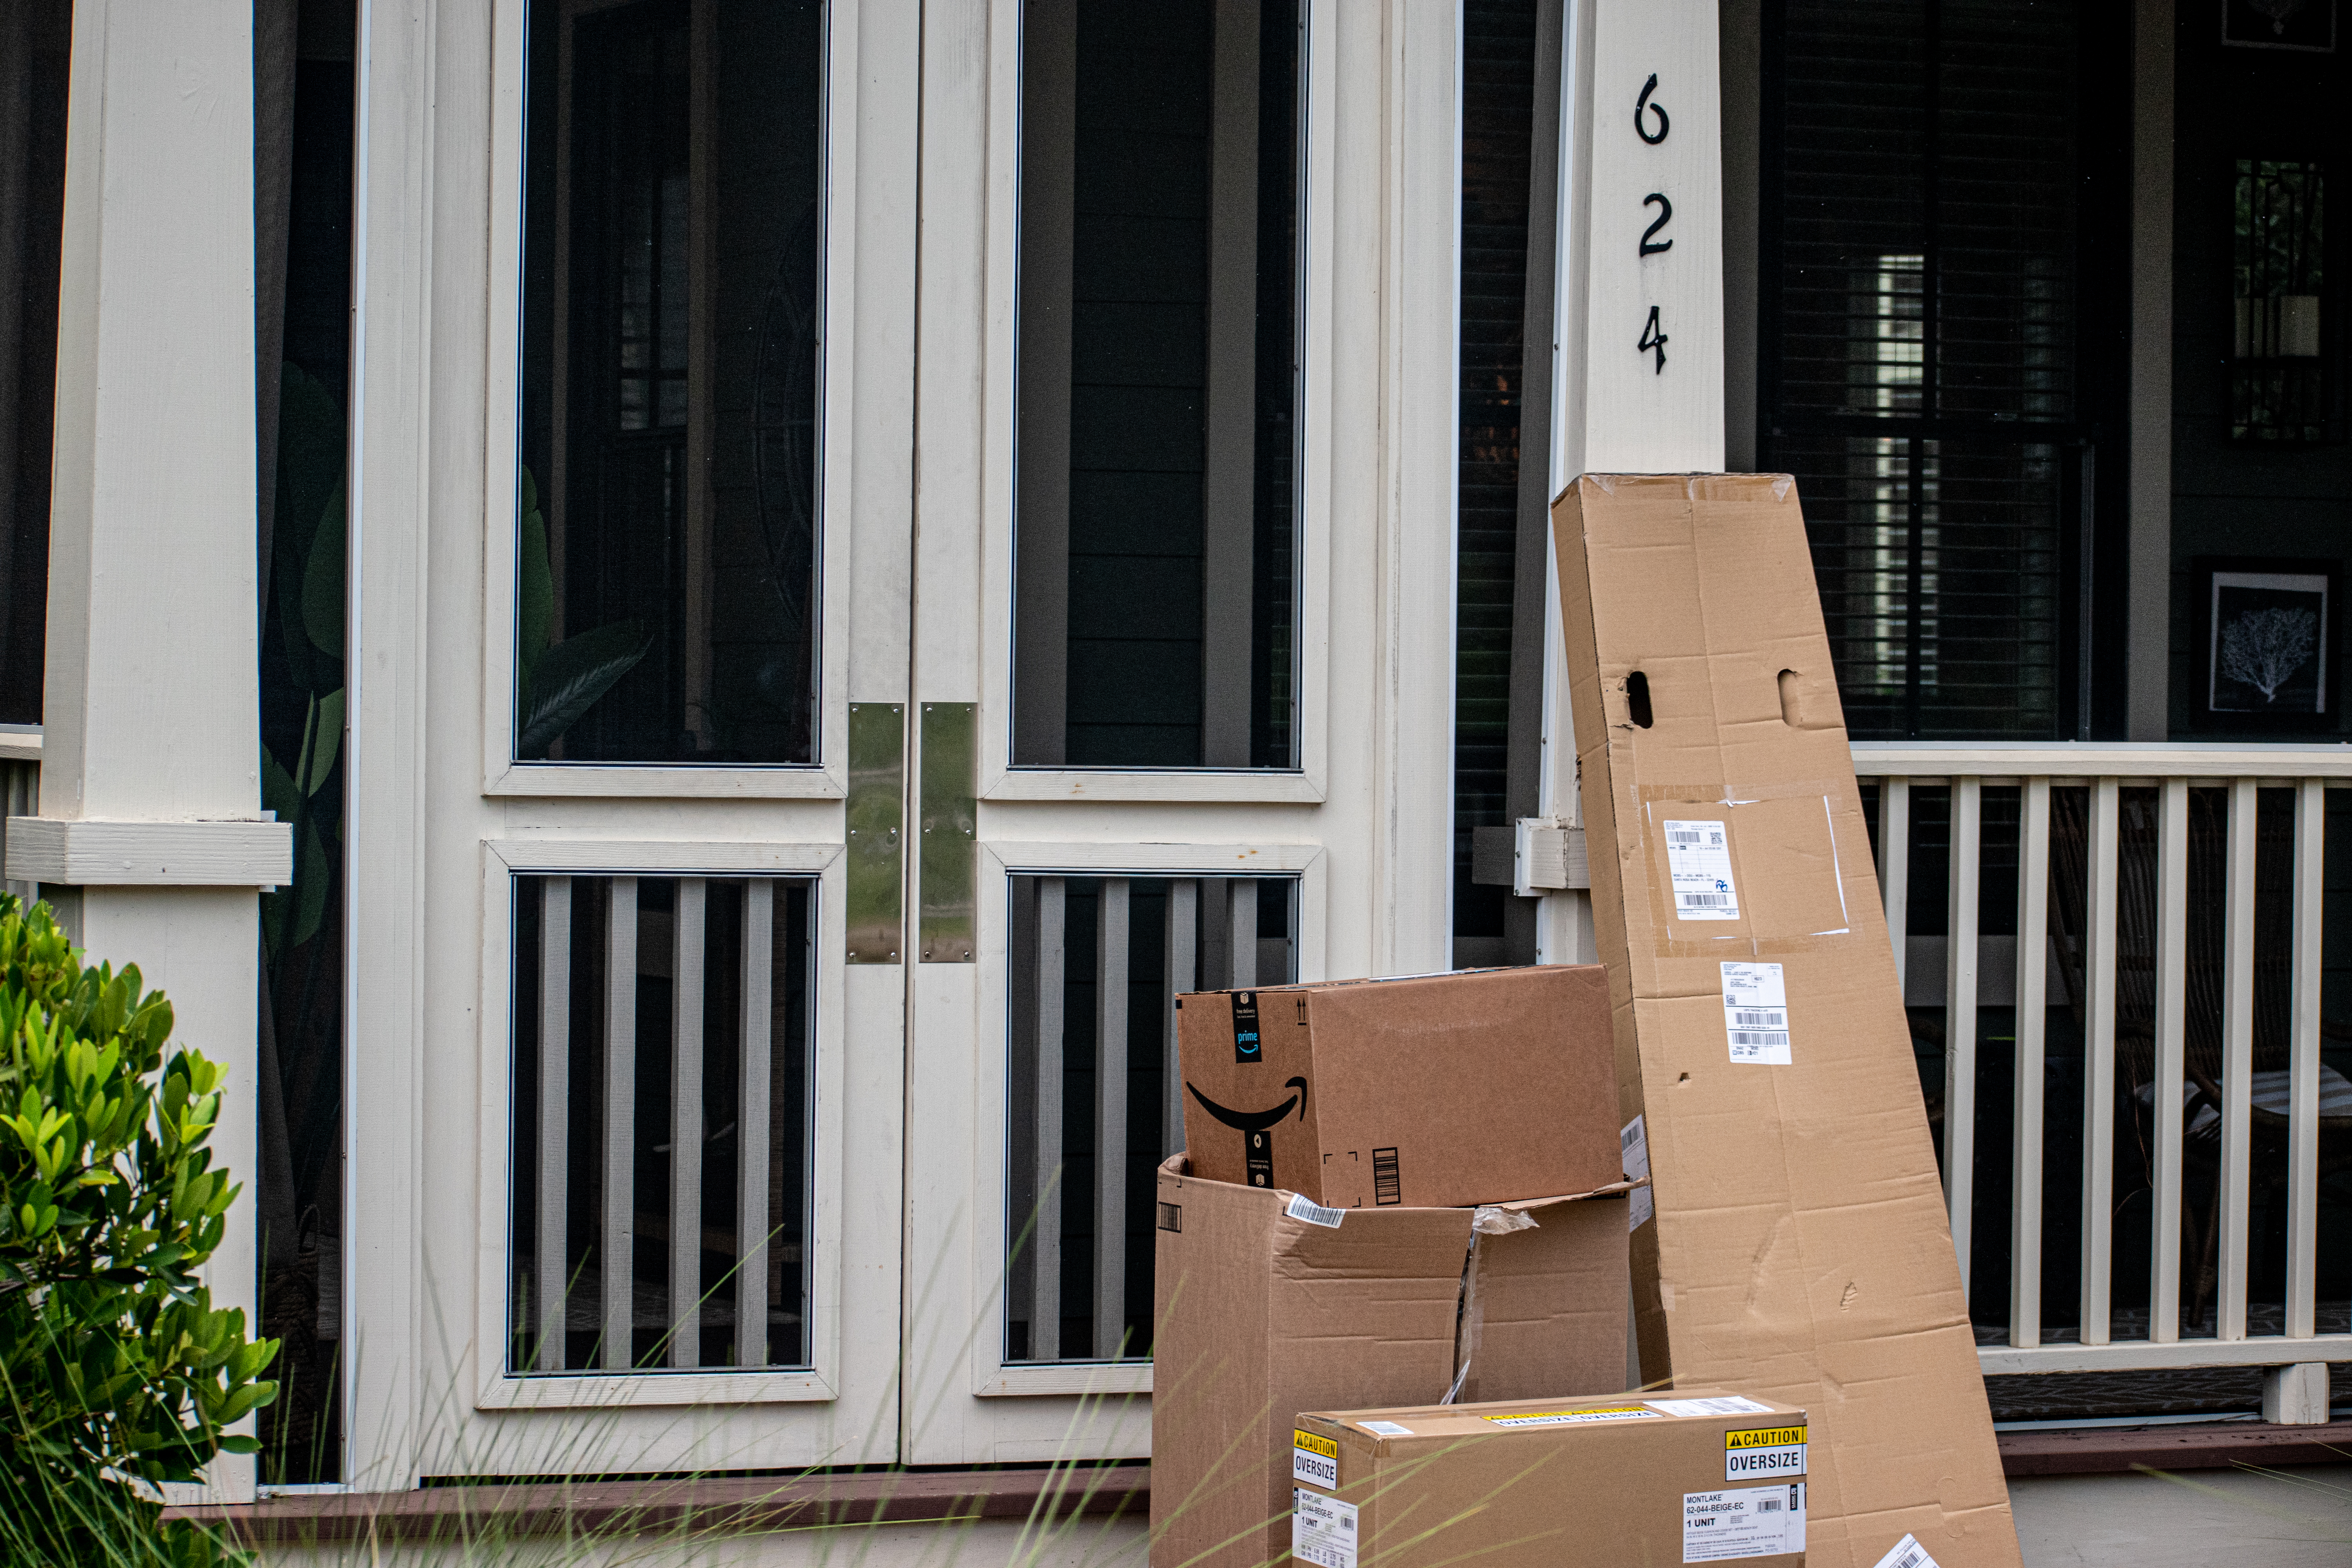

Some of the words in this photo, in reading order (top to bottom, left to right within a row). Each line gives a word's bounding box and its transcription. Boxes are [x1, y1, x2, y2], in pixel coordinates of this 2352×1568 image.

[1238, 1030, 1258, 1044] prime
[1499, 1417, 1575, 1425] OVERSIZE
[1744, 1430, 1798, 1445] CAUTION
[1304, 1435, 1335, 1456] CAUTION
[1296, 1455, 1334, 1481] OVERSIZE
[1730, 1452, 1798, 1471] OVERSIZE
[1302, 1492, 1322, 1505] MONTLAKE
[1687, 1494, 1722, 1504] MONTLAKE
[1302, 1503, 1333, 1519] 62-044-BEIGE-EC
[1687, 1502, 1744, 1514] 62-044-BEIGE-EC
[1302, 1516, 1305, 1524] 1
[1306, 1517, 1318, 1528] UNIT
[1695, 1517, 1716, 1527] UNIT
